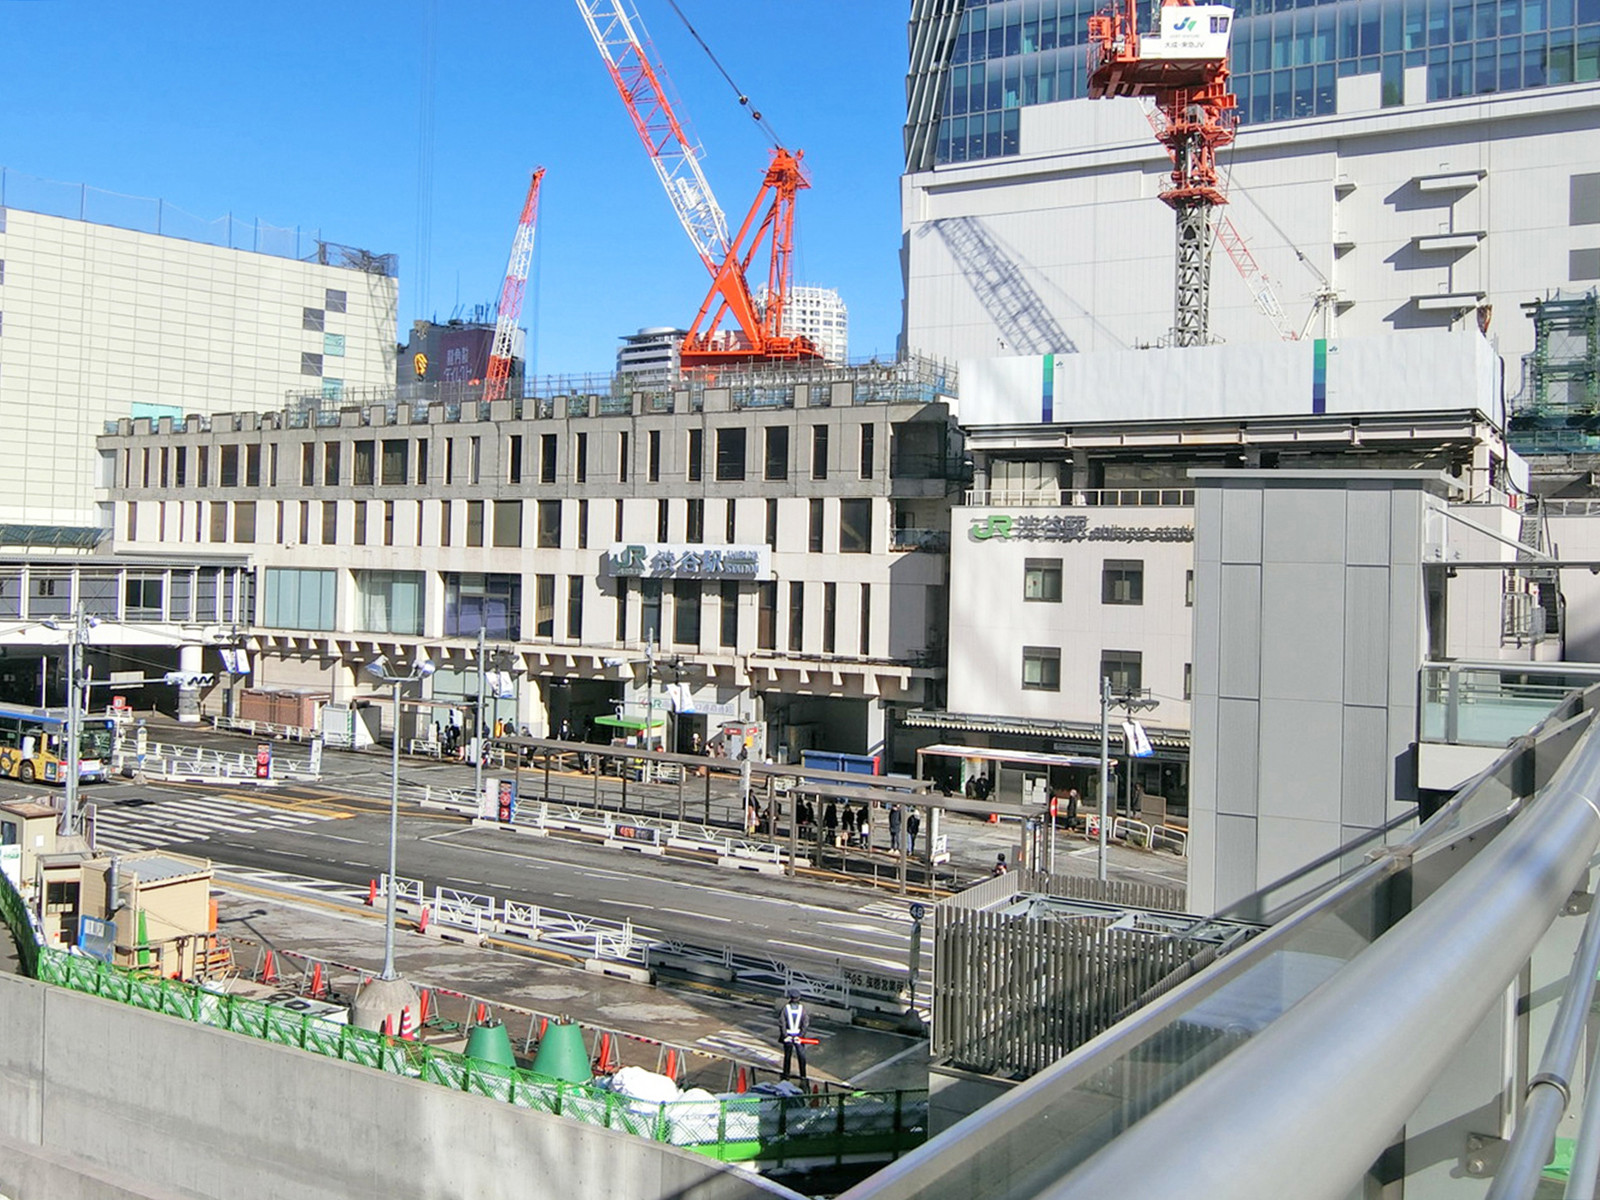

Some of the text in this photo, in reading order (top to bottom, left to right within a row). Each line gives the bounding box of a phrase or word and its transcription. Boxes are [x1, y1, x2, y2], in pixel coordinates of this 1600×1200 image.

[973, 515, 1012, 539] JR
[1017, 515, 1089, 541] 渋谷駅
[615, 545, 723, 573] JR 渋谷駅
[910, 906, 923, 917] 48
